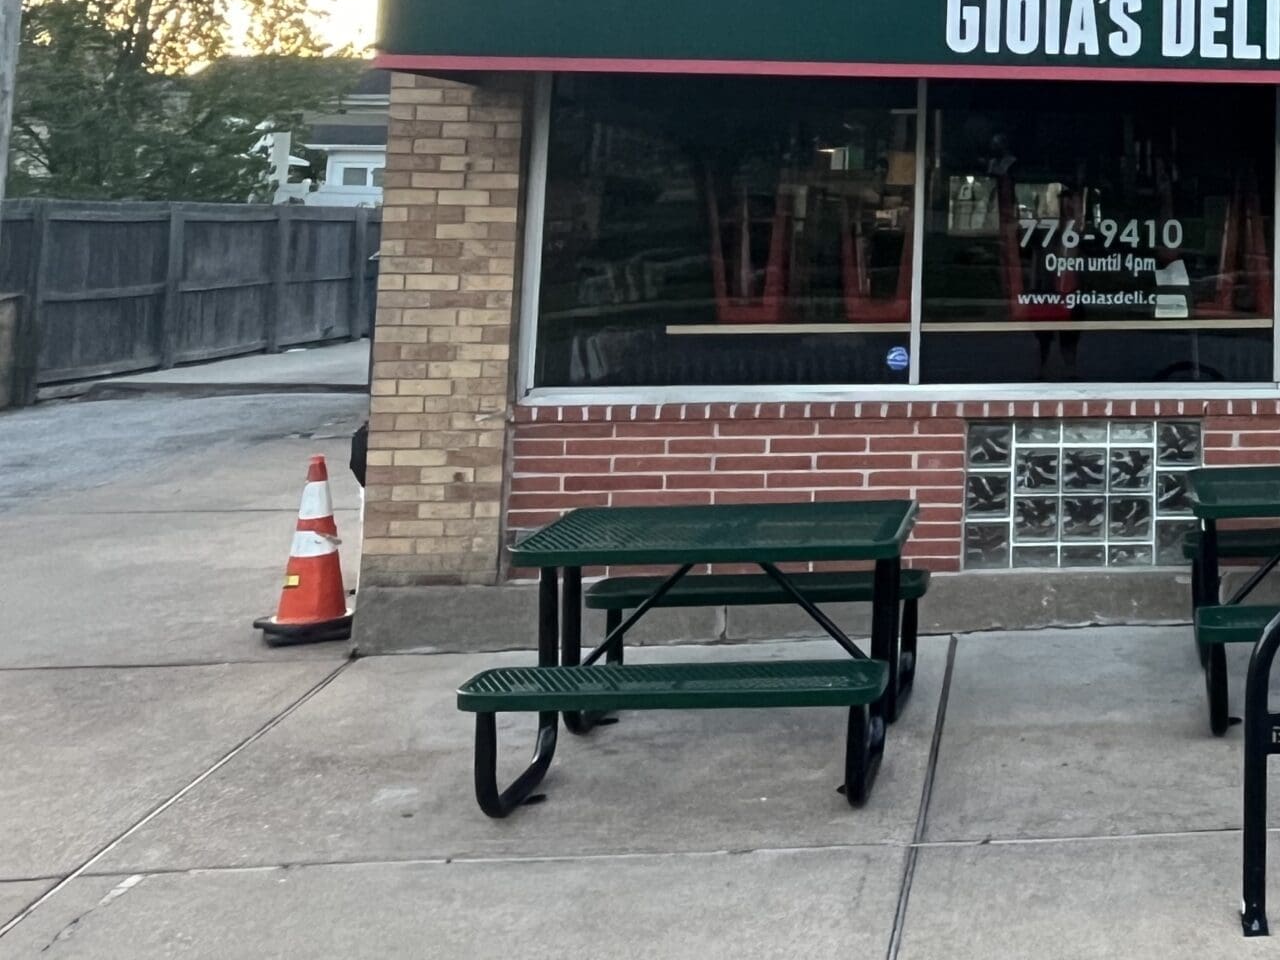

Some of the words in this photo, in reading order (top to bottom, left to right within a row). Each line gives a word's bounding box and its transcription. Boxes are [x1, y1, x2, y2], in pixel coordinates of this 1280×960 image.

[1019, 218, 1183, 249] 776-9410
[1045, 253, 1084, 277] Open
[1088, 253, 1121, 272] until
[1124, 253, 1156, 277] 4pm
[1018, 290, 1157, 309] www.gioiasdeli.c
